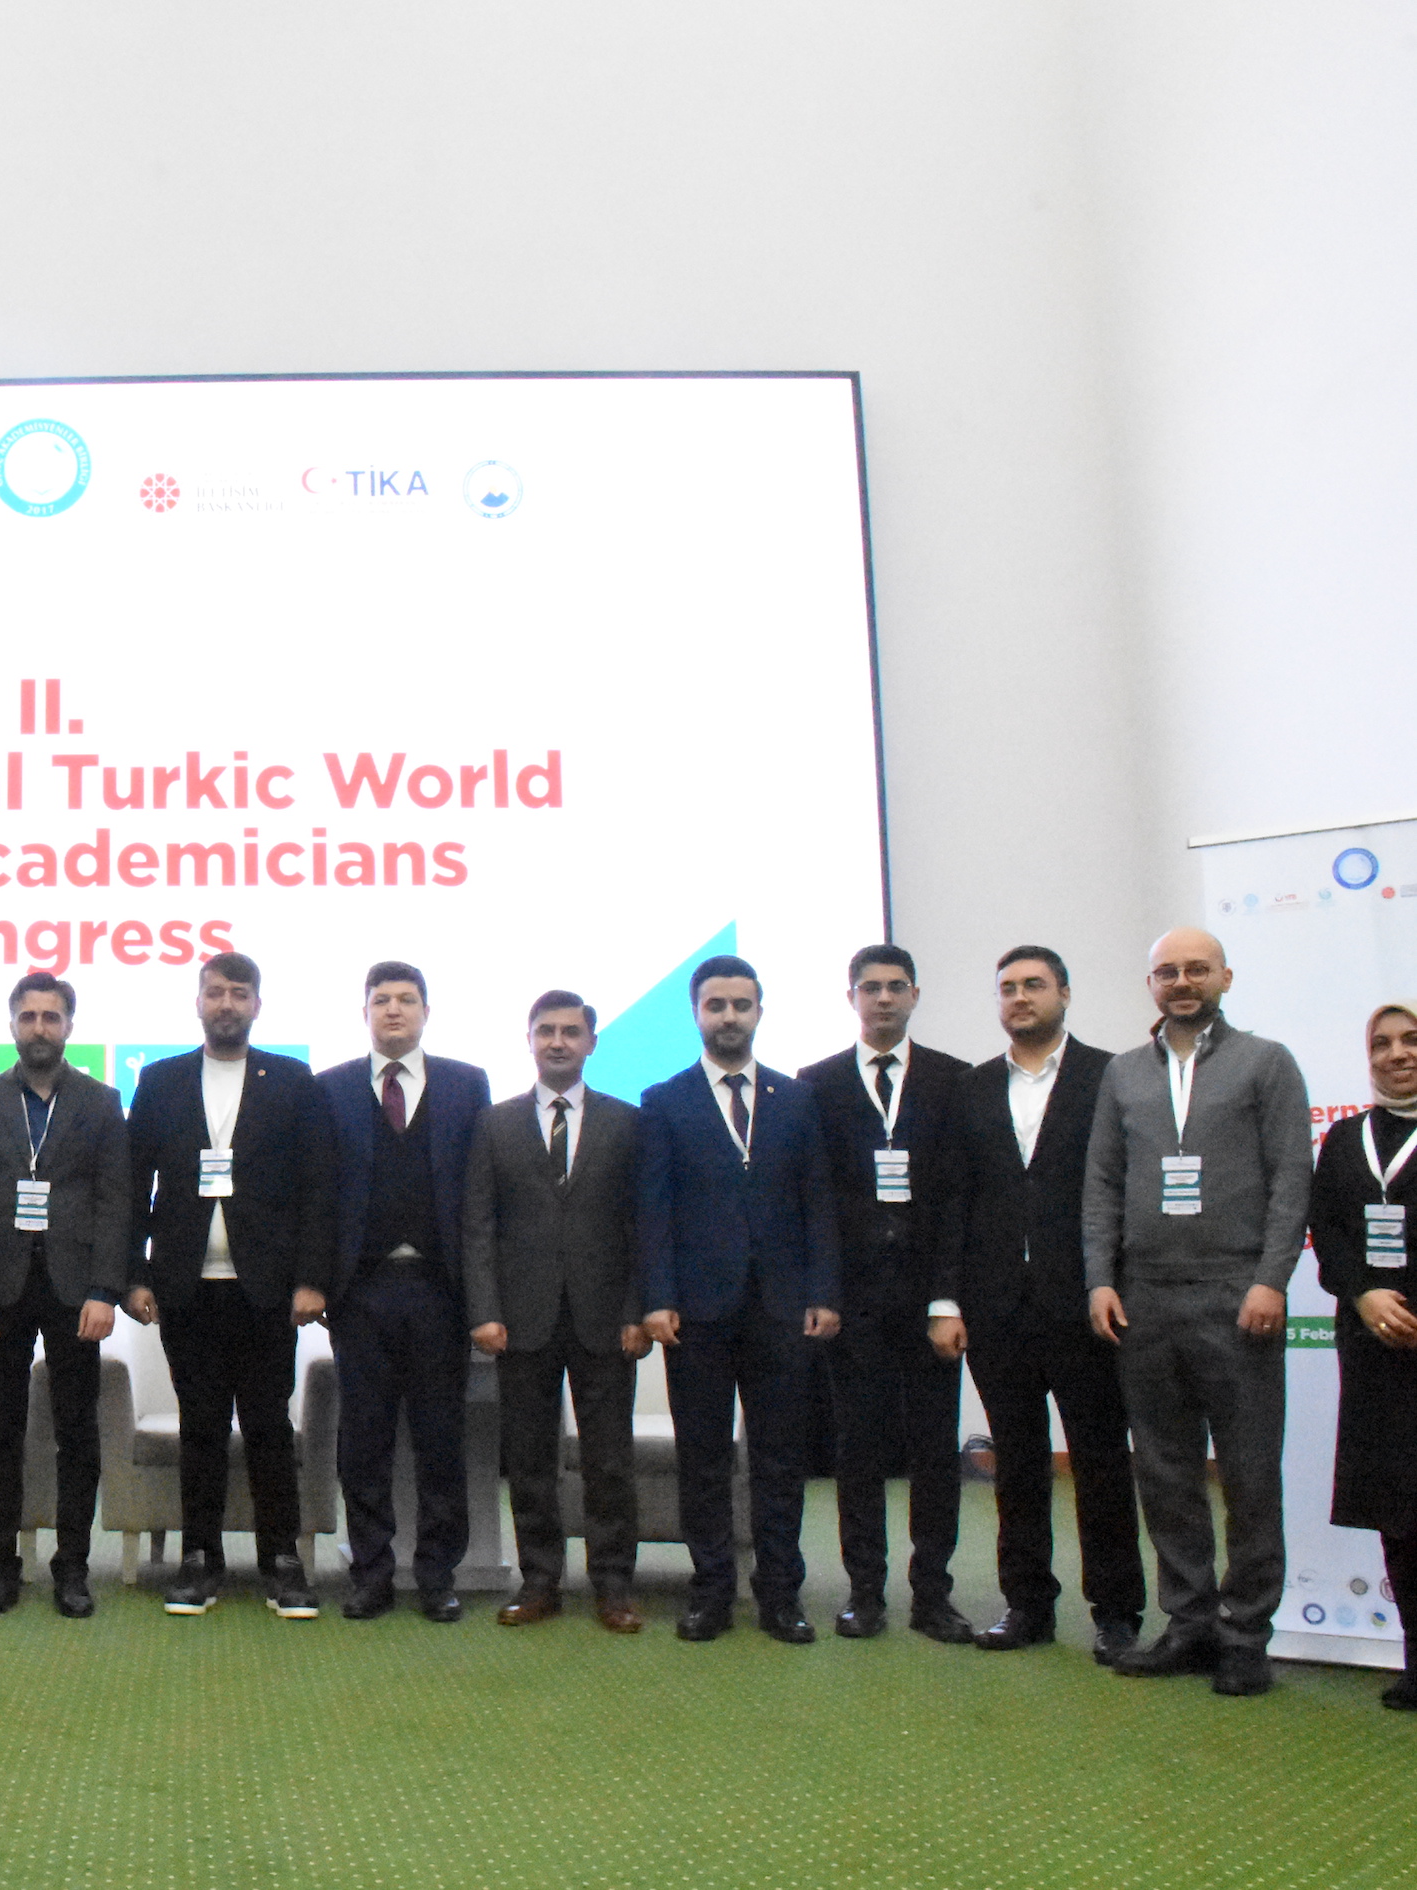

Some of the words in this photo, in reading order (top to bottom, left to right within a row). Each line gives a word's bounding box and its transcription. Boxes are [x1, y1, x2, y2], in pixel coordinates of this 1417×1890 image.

[345, 464, 429, 496] TİKA
[25, 503, 55, 515] 2017
[20, 678, 84, 735] II.
[51, 750, 295, 811] Turkic
[322, 748, 563, 810] World
